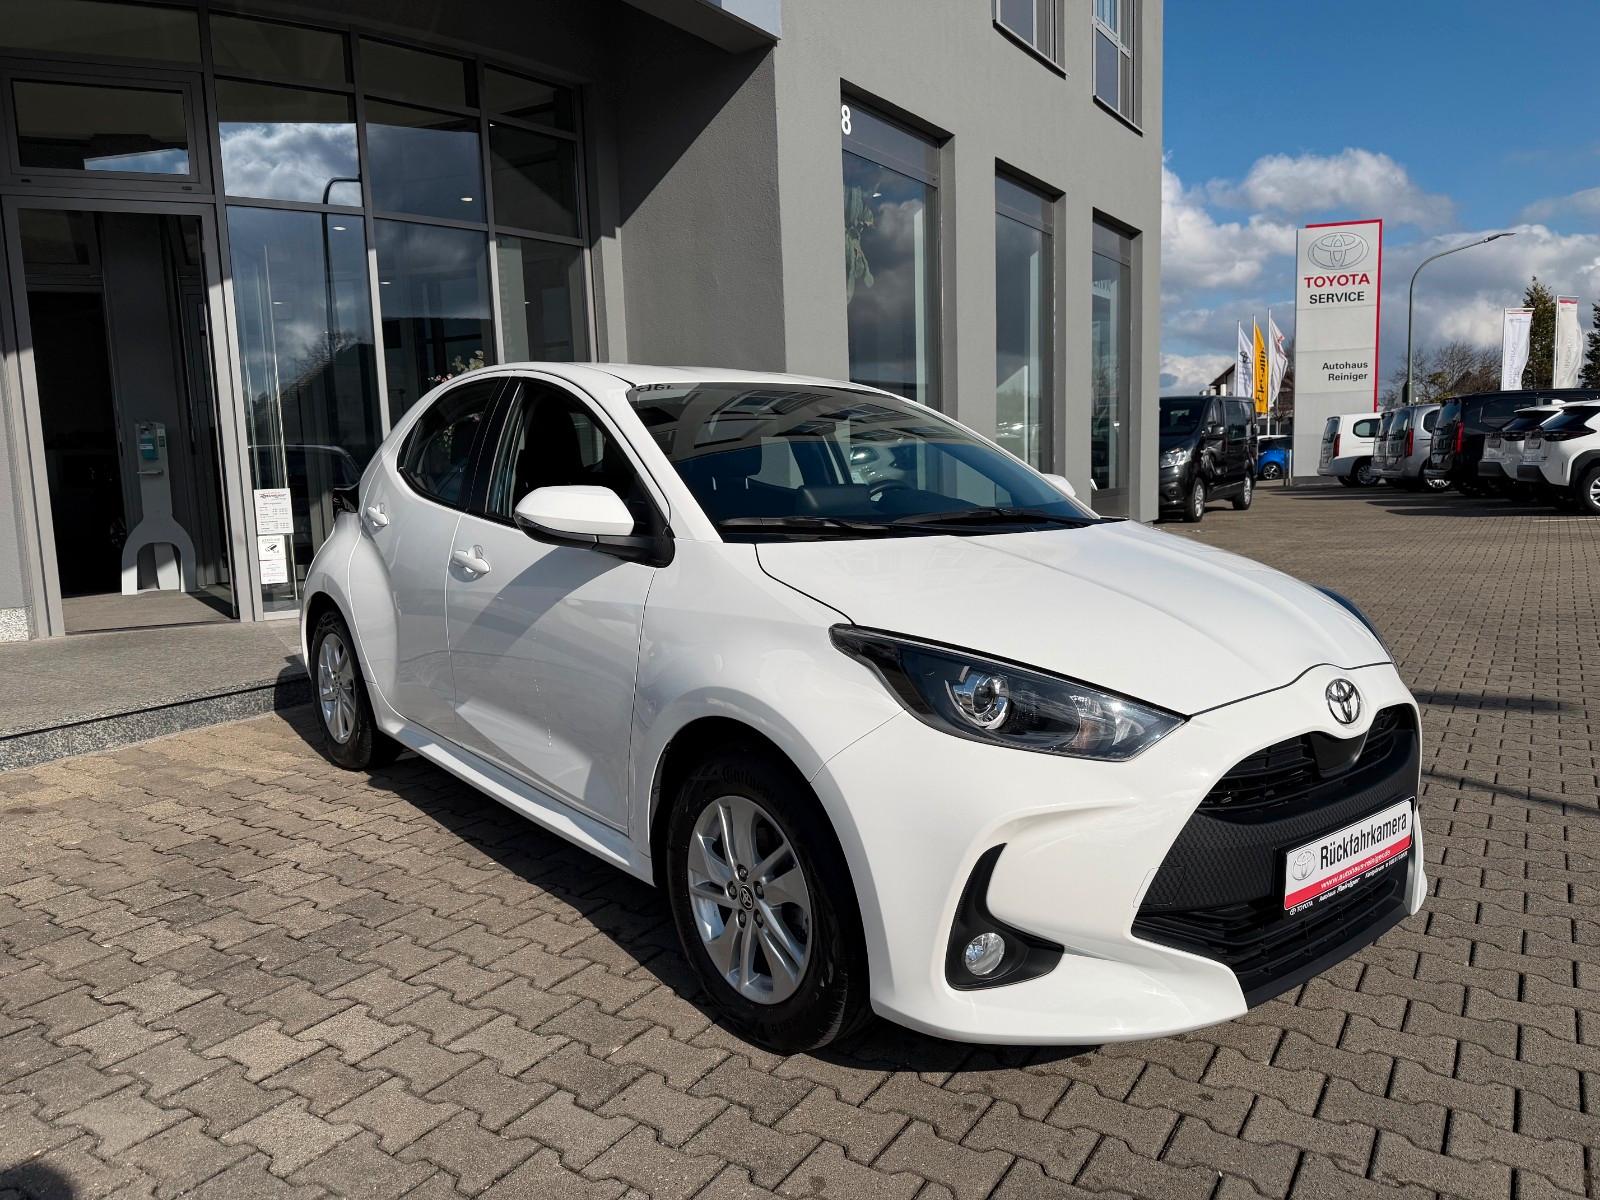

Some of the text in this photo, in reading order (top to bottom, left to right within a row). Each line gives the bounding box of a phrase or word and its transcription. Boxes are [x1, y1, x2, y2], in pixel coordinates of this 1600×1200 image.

[841, 104, 852, 136] 8
[1304, 273, 1370, 288] TOYOTA
[1309, 291, 1365, 305] SERVICE
[1322, 361, 1368, 371] Autohaus
[1328, 373, 1368, 382] Reiniger
[1320, 813, 1407, 870] Rückfahrkamera
